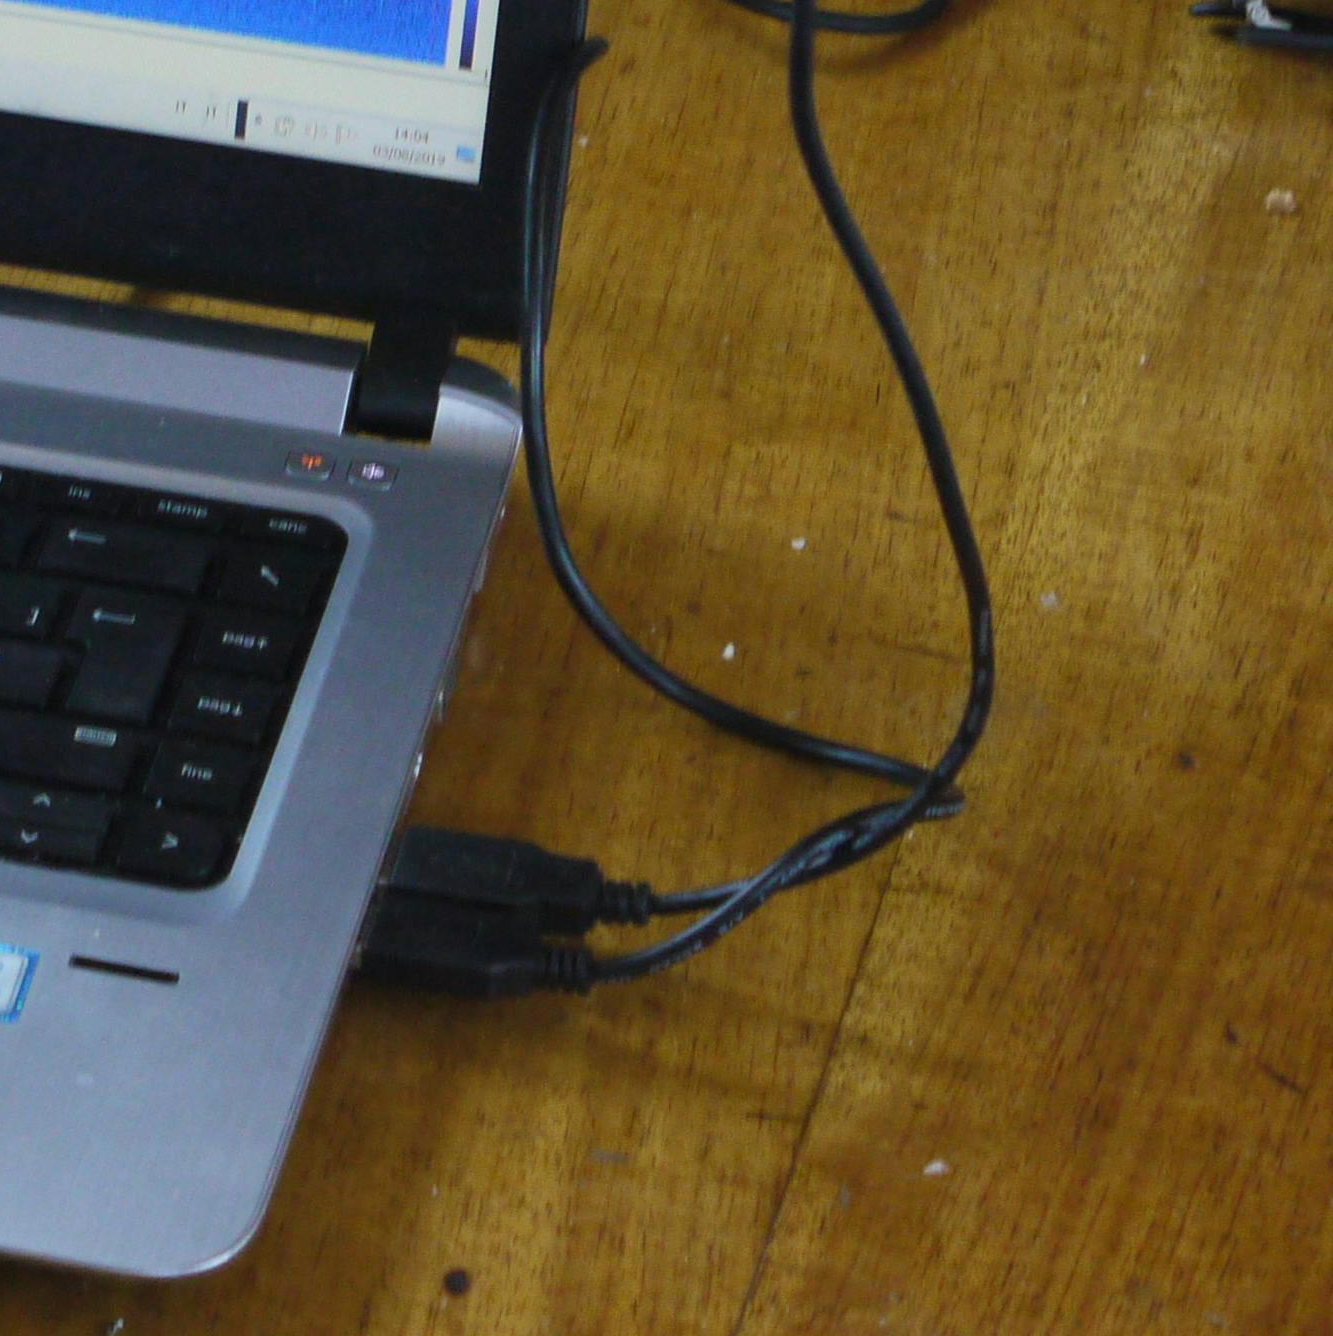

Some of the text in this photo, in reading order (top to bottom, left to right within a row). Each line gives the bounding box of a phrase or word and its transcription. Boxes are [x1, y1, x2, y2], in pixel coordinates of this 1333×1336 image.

[393, 126, 431, 145] 14:04
[157, 498, 209, 520] stamp
[181, 761, 213, 782] fine
